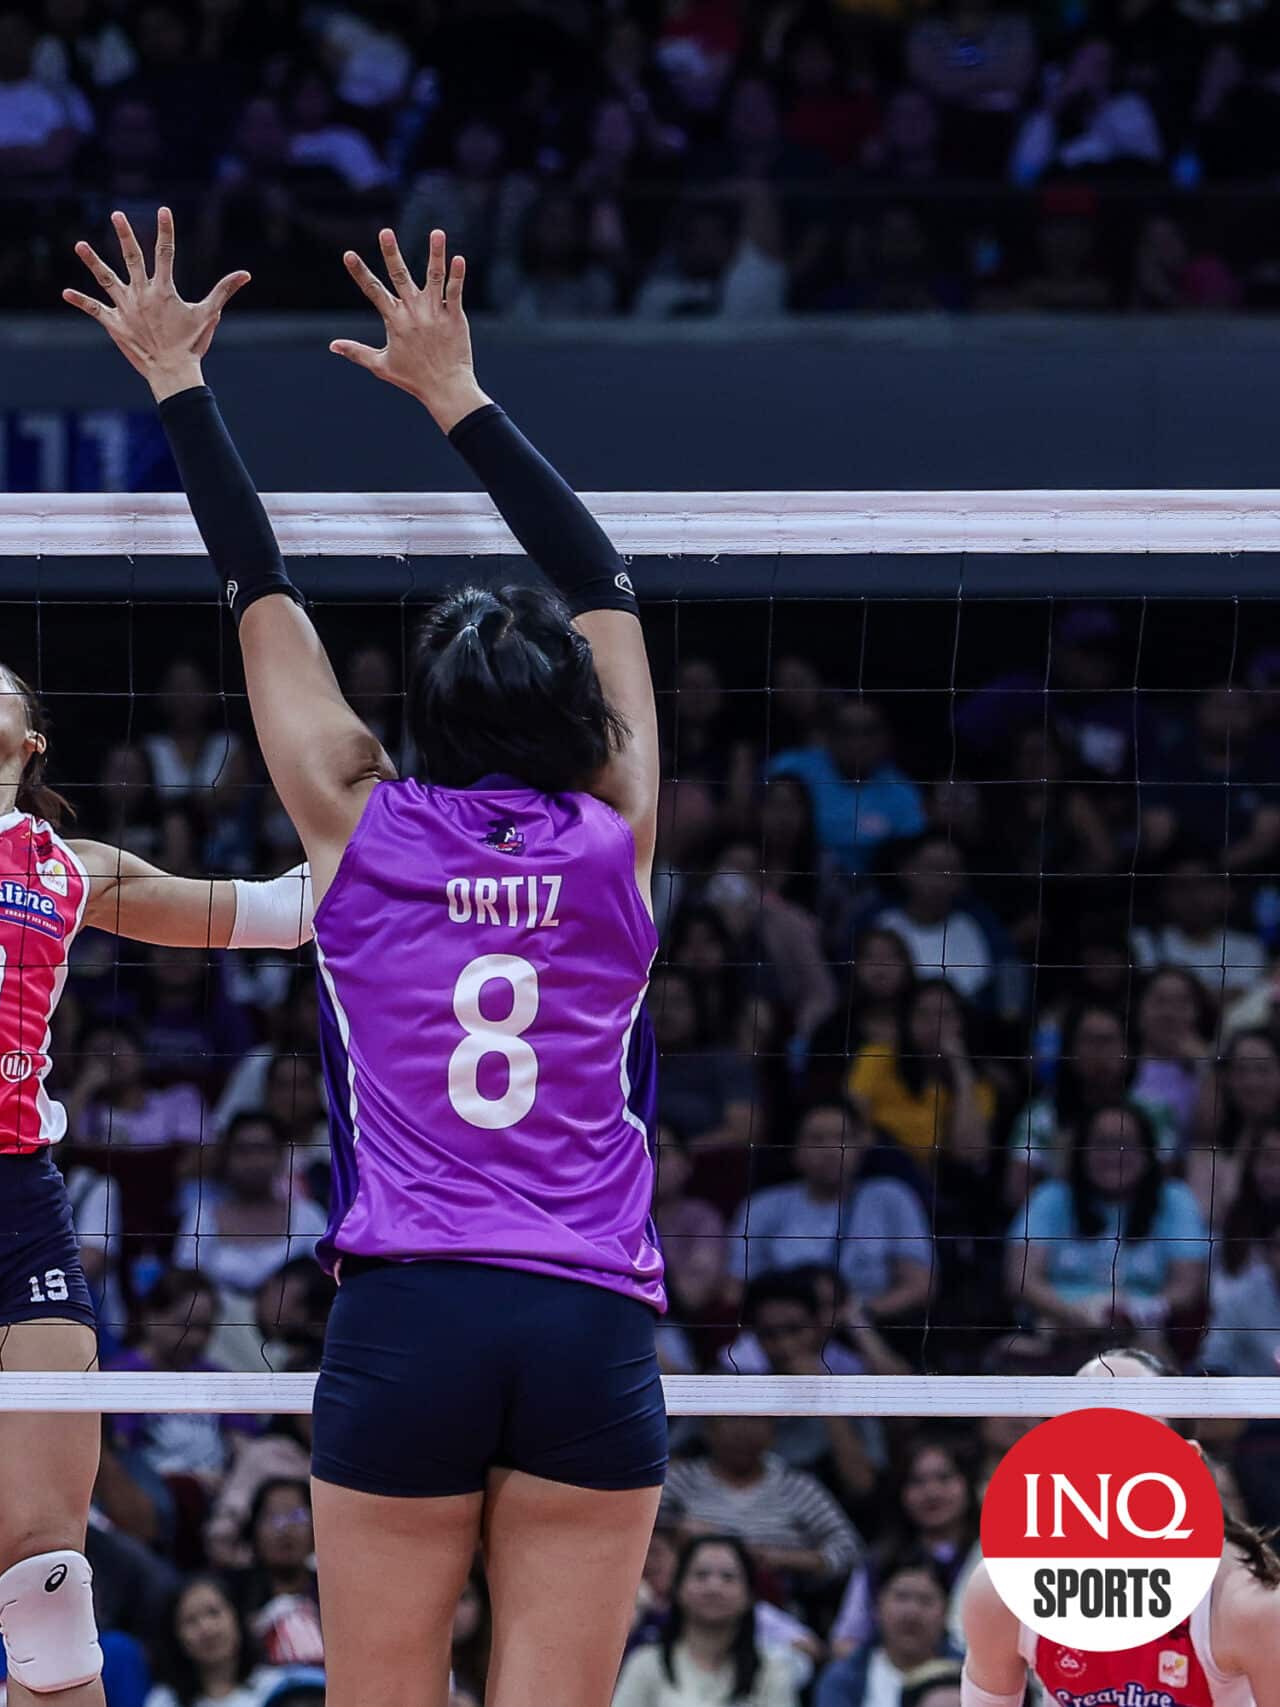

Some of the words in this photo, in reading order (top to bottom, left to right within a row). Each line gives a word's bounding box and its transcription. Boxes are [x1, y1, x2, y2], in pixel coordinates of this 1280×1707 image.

[446, 875, 562, 929] ORTIZ
[448, 953, 539, 1130] 8
[28, 1268, 69, 1303] 19
